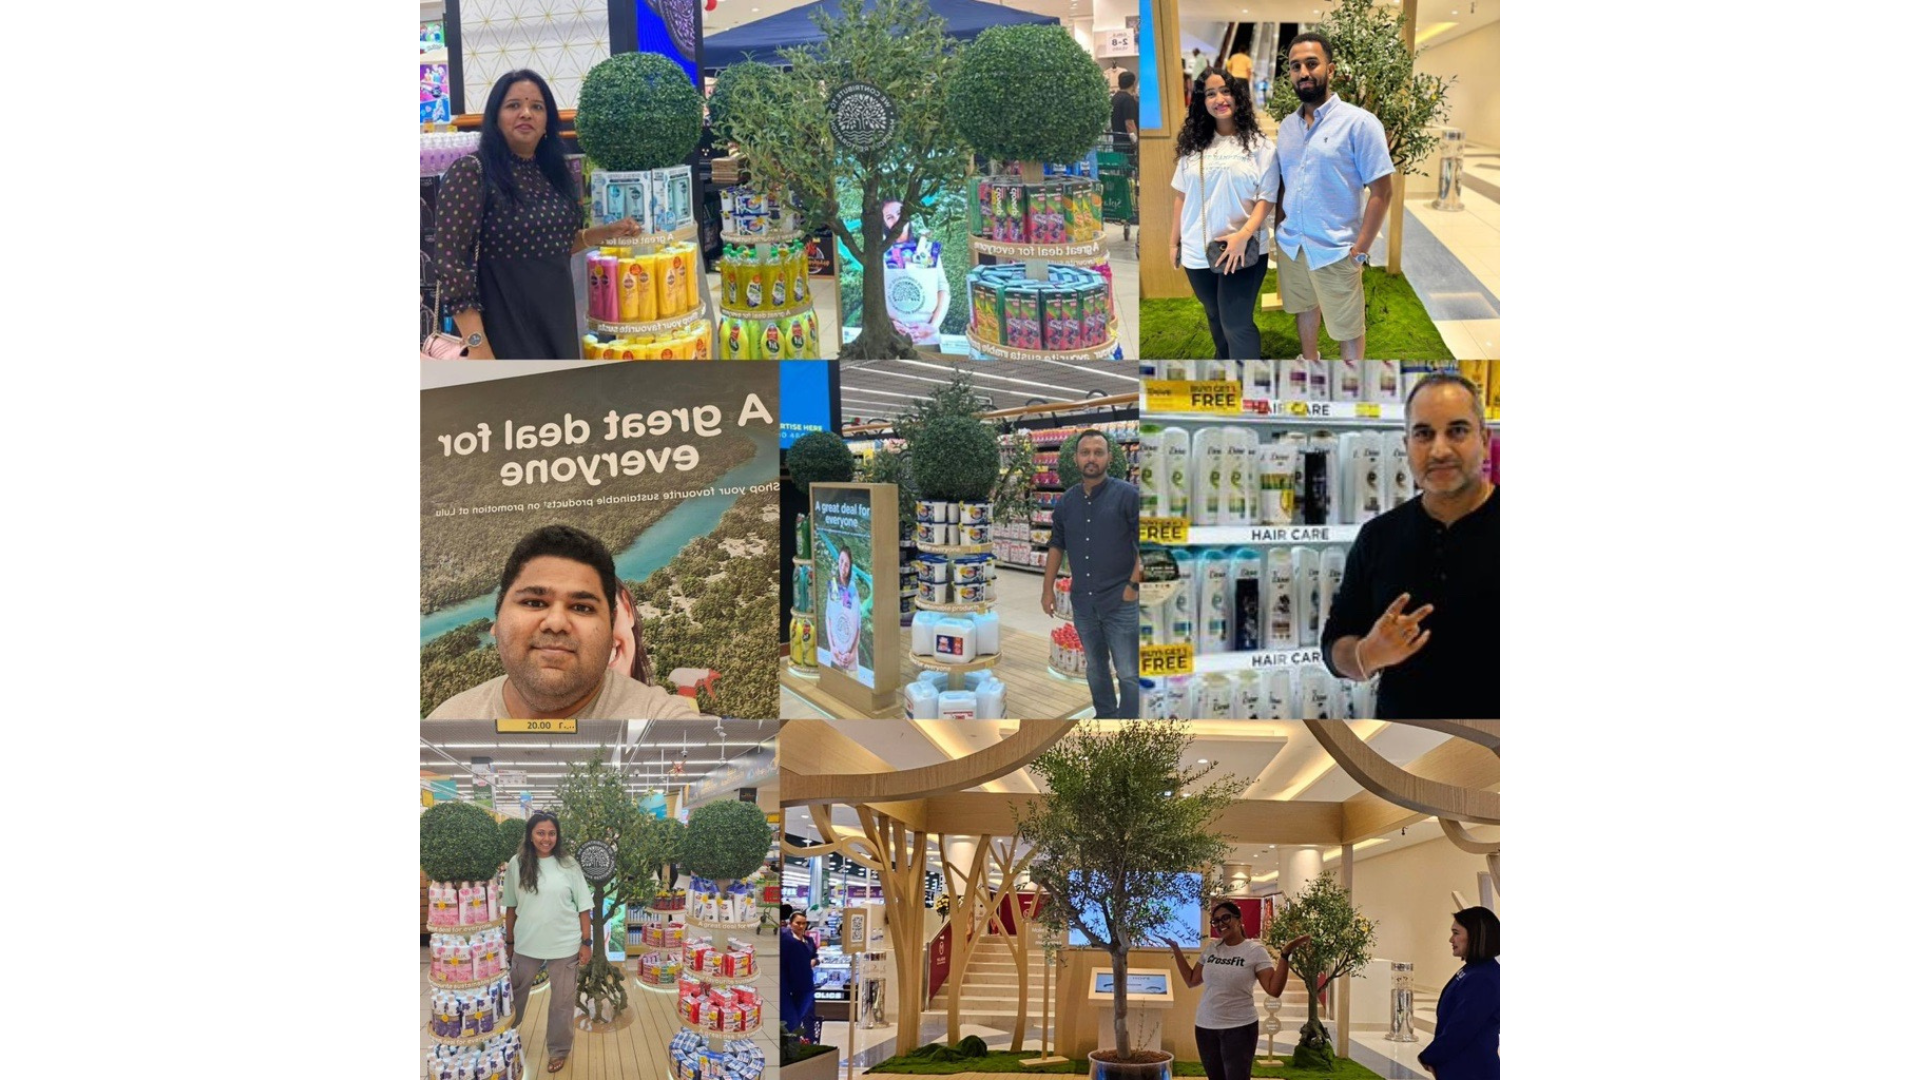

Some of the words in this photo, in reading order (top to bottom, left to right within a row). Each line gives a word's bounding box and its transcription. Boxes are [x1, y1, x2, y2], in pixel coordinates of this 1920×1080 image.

[1191, 393, 1236, 407] FREE
[1290, 402, 1330, 415] CARE
[815, 501, 821, 511] A
[821, 502, 840, 514] great
[841, 502, 858, 515] deal
[858, 503, 871, 516] for
[825, 515, 858, 528] everyone
[1252, 529, 1287, 541] HAIR
[1291, 528, 1330, 541] CARE
[1142, 656, 1188, 672] FREE
[1252, 655, 1286, 667] HAIR
[1290, 653, 1321, 663] CAR
[527, 721, 552, 730] 20.00
[1207, 954, 1246, 967] CrossFit
